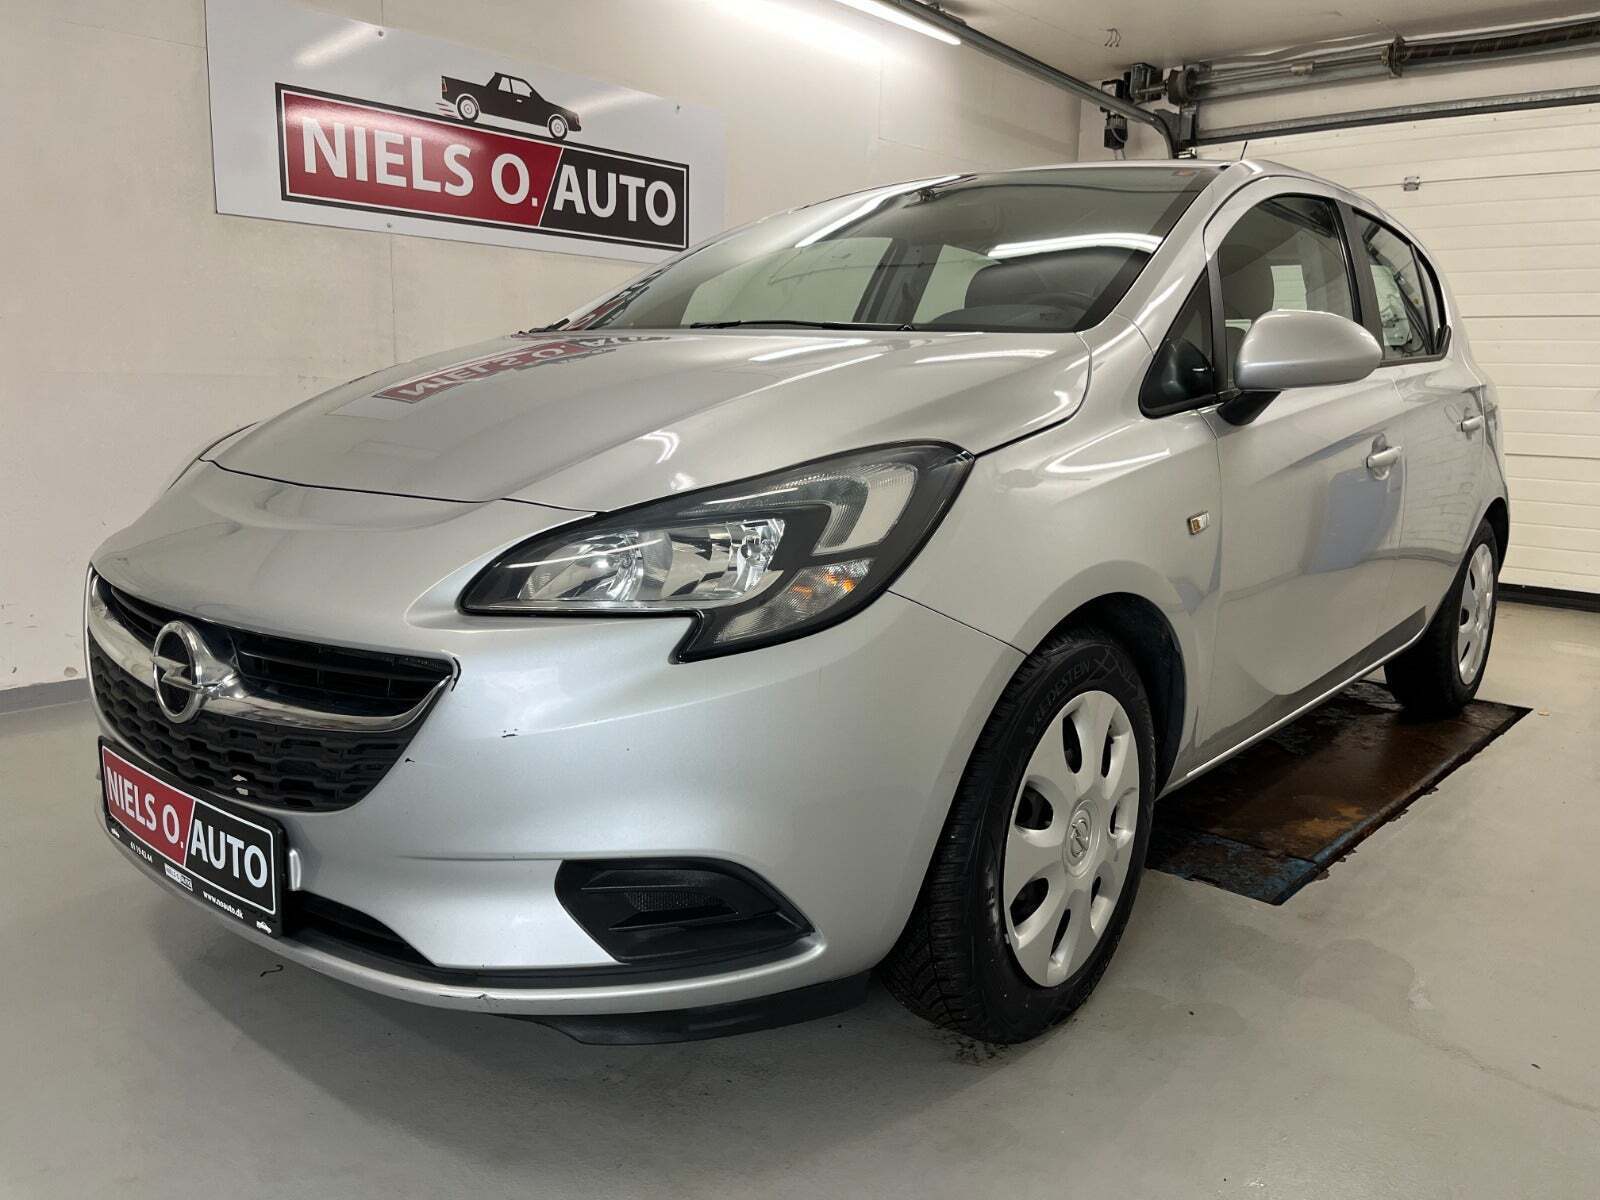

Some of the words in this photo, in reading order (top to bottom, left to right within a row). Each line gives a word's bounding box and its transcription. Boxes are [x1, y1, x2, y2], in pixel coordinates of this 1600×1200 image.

[301, 117, 474, 198] NIELS
[491, 153, 538, 208] O.
[553, 164, 677, 227] AUTO
[106, 766, 157, 832] NIELS
[162, 804, 184, 849] O.
[190, 818, 268, 888] AUTO
